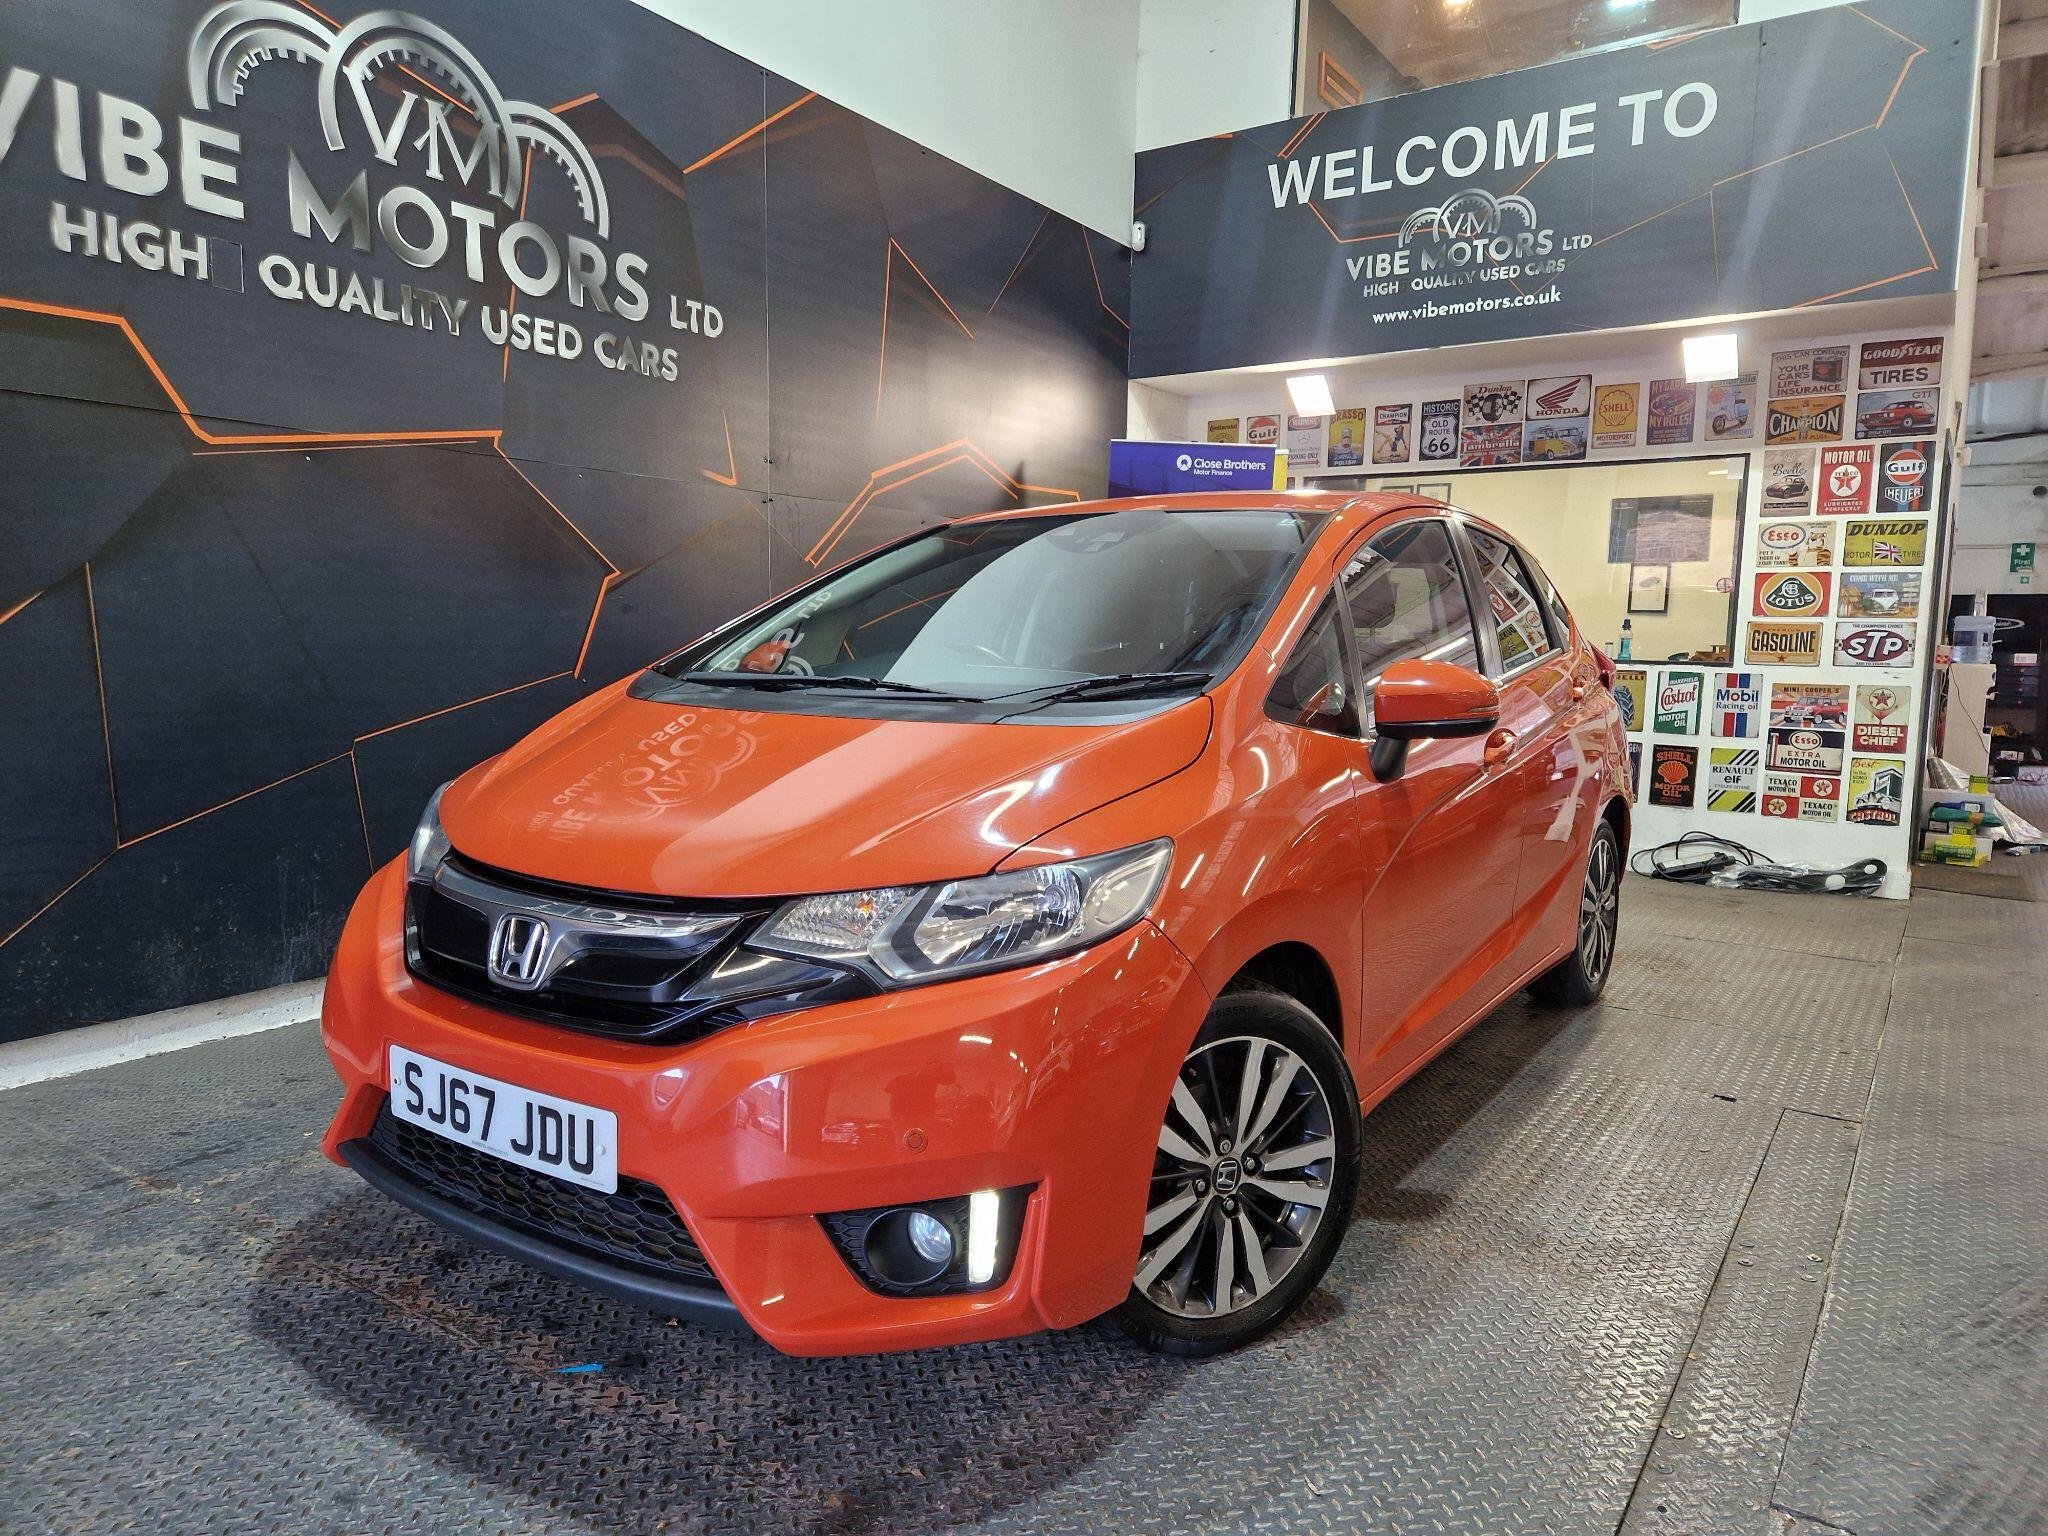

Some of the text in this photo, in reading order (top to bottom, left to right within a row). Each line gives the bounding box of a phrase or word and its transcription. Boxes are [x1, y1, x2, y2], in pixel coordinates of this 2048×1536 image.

[1267, 81, 1718, 208] WELCOME TO
[288, 148, 650, 323] MOTORS
[670, 295, 724, 340] LTD
[1346, 228, 1593, 282] VIBE MOTORS LTD
[1363, 258, 1567, 298] HIGH QUALITY USED CARS
[52, 200, 679, 382] HIGH QUALITY USED CARS
[1372, 285, 1562, 324] www.vibemotors.co.uk
[1775, 348, 1847, 361] THIS CAN CONTAINS
[1863, 343, 1942, 360] GOODYEAR
[1778, 364, 1810, 373] YOUR
[1777, 371, 1810, 380] CAR'S
[1870, 367, 1929, 385] TIRES
[1478, 384, 1513, 394] Dunlop
[1776, 384, 1842, 396] INSURANCE
[1777, 380, 1801, 389] LIFE
[1912, 391, 1932, 399] GTI
[1423, 402, 1459, 413] HISTORIC
[1535, 407, 1580, 417] HONDA
[1603, 403, 1630, 412] SHELL
[1332, 410, 1364, 422] BRASSO
[1380, 411, 1407, 420] CHAMPION
[1769, 407, 1840, 436] CHAMPION
[1431, 419, 1449, 428] OLD
[1248, 427, 1278, 439] Gulf
[1428, 428, 1451, 436] ROUTE
[1596, 433, 1633, 441] MOTORSPORT
[1427, 437, 1450, 453] 66
[1824, 449, 1871, 465] MOTOR OIL
[1193, 458, 1266, 471] Close Brothers
[1887, 461, 1925, 473] Gulf
[1887, 487, 1921, 503] HEUER
[1847, 523, 1927, 536] DUNLOP
[1768, 593, 1815, 607] LOTUS
[1751, 629, 1817, 653] GASOLINE
[1847, 631, 1903, 659] STP
[1669, 676, 1699, 685] WAKEFIELD
[1661, 684, 1698, 711] Castrol
[1716, 689, 1759, 702] Mobil
[1715, 701, 1759, 711] Racing oil
[1659, 712, 1686, 722] MOTOR
[1856, 725, 1905, 737] DIESEL
[1859, 735, 1899, 746] CHIEF
[1656, 750, 1694, 765] SHELL
[1787, 750, 1821, 759] EXTRA
[1780, 757, 1827, 769] MOTOR OIL
[1712, 765, 1755, 775] RENAULT
[1723, 775, 1742, 784] elf
[1769, 777, 1798, 786] TEXACO
[1654, 781, 1690, 792] MOTOR
[1767, 785, 1797, 794] MOTOR OIL
[1662, 789, 1682, 798] OIL
[1803, 801, 1833, 810] TEXACO
[1802, 809, 1822, 817] MOTOR
[404, 1061, 594, 1176] SJ67 JDU
